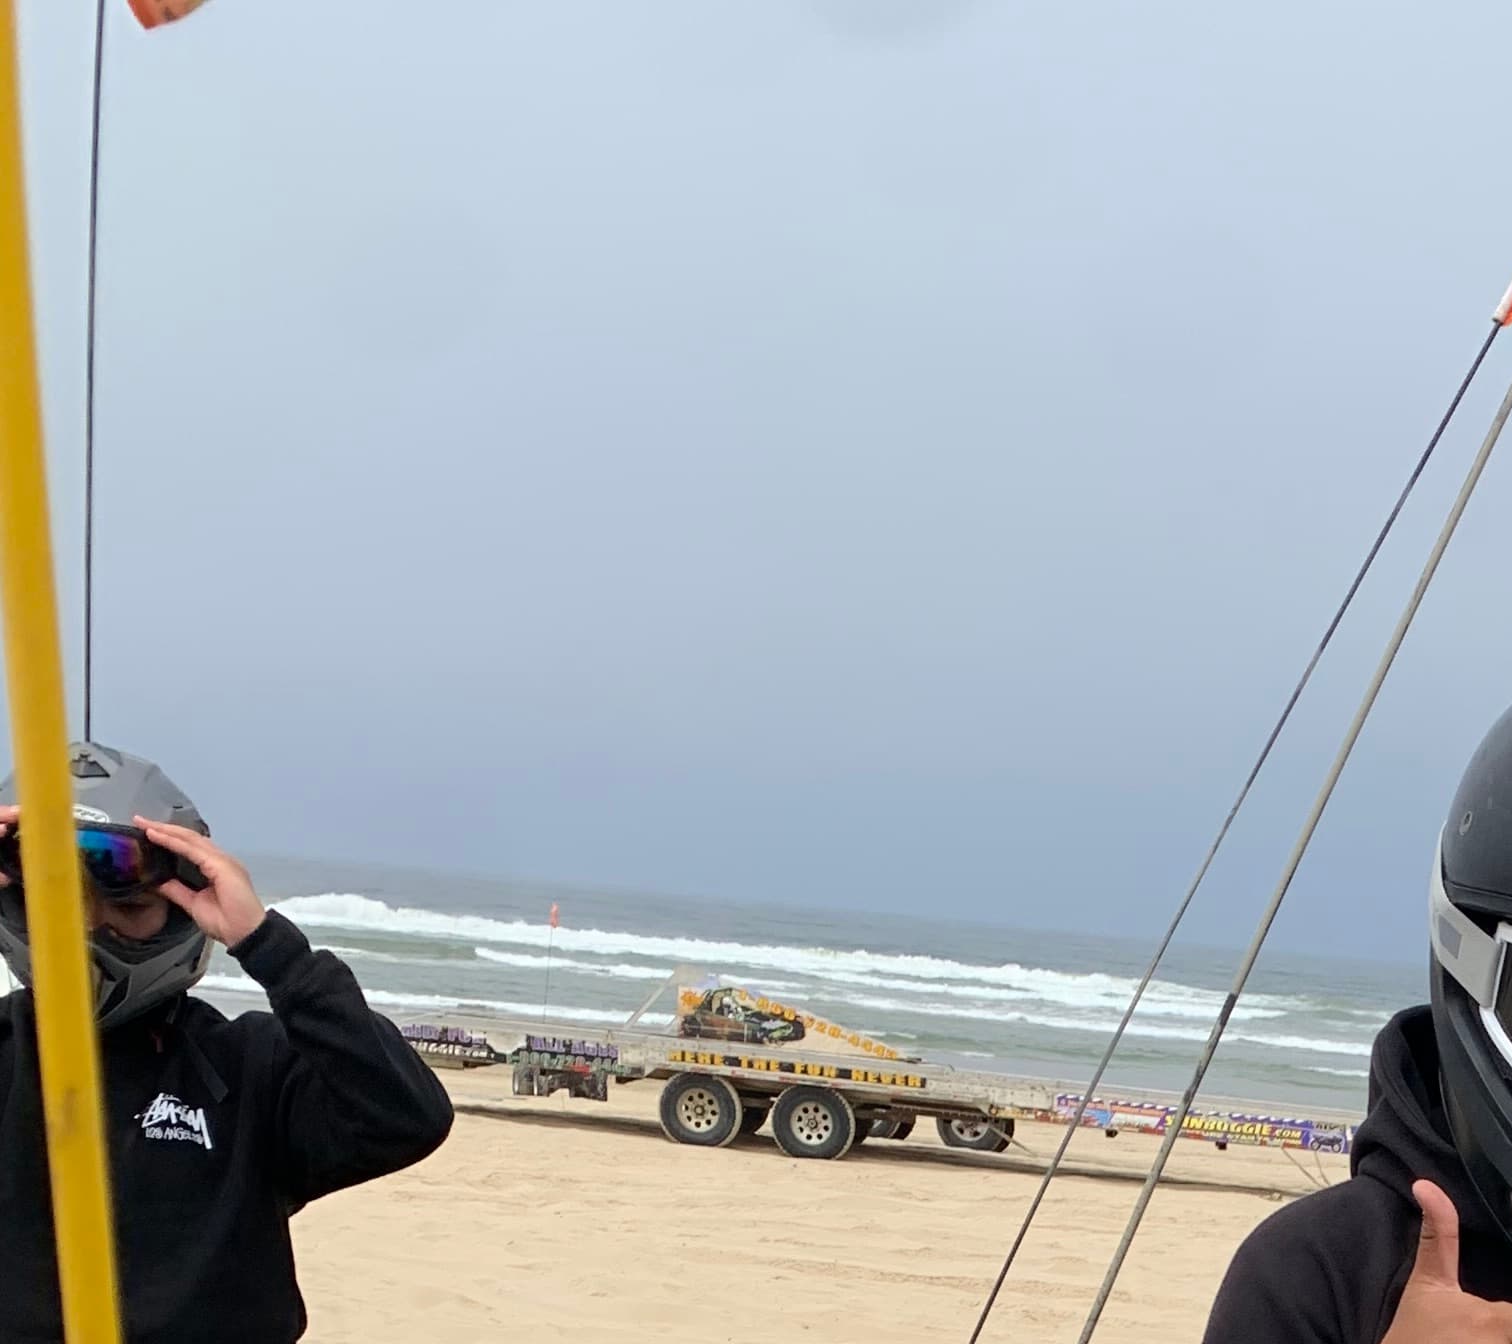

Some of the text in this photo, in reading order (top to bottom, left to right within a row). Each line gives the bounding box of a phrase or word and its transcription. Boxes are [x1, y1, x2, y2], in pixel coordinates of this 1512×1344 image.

[740, 1056, 779, 1072] THE
[795, 1062, 837, 1078] FUN
[851, 1069, 921, 1089] NEVER
